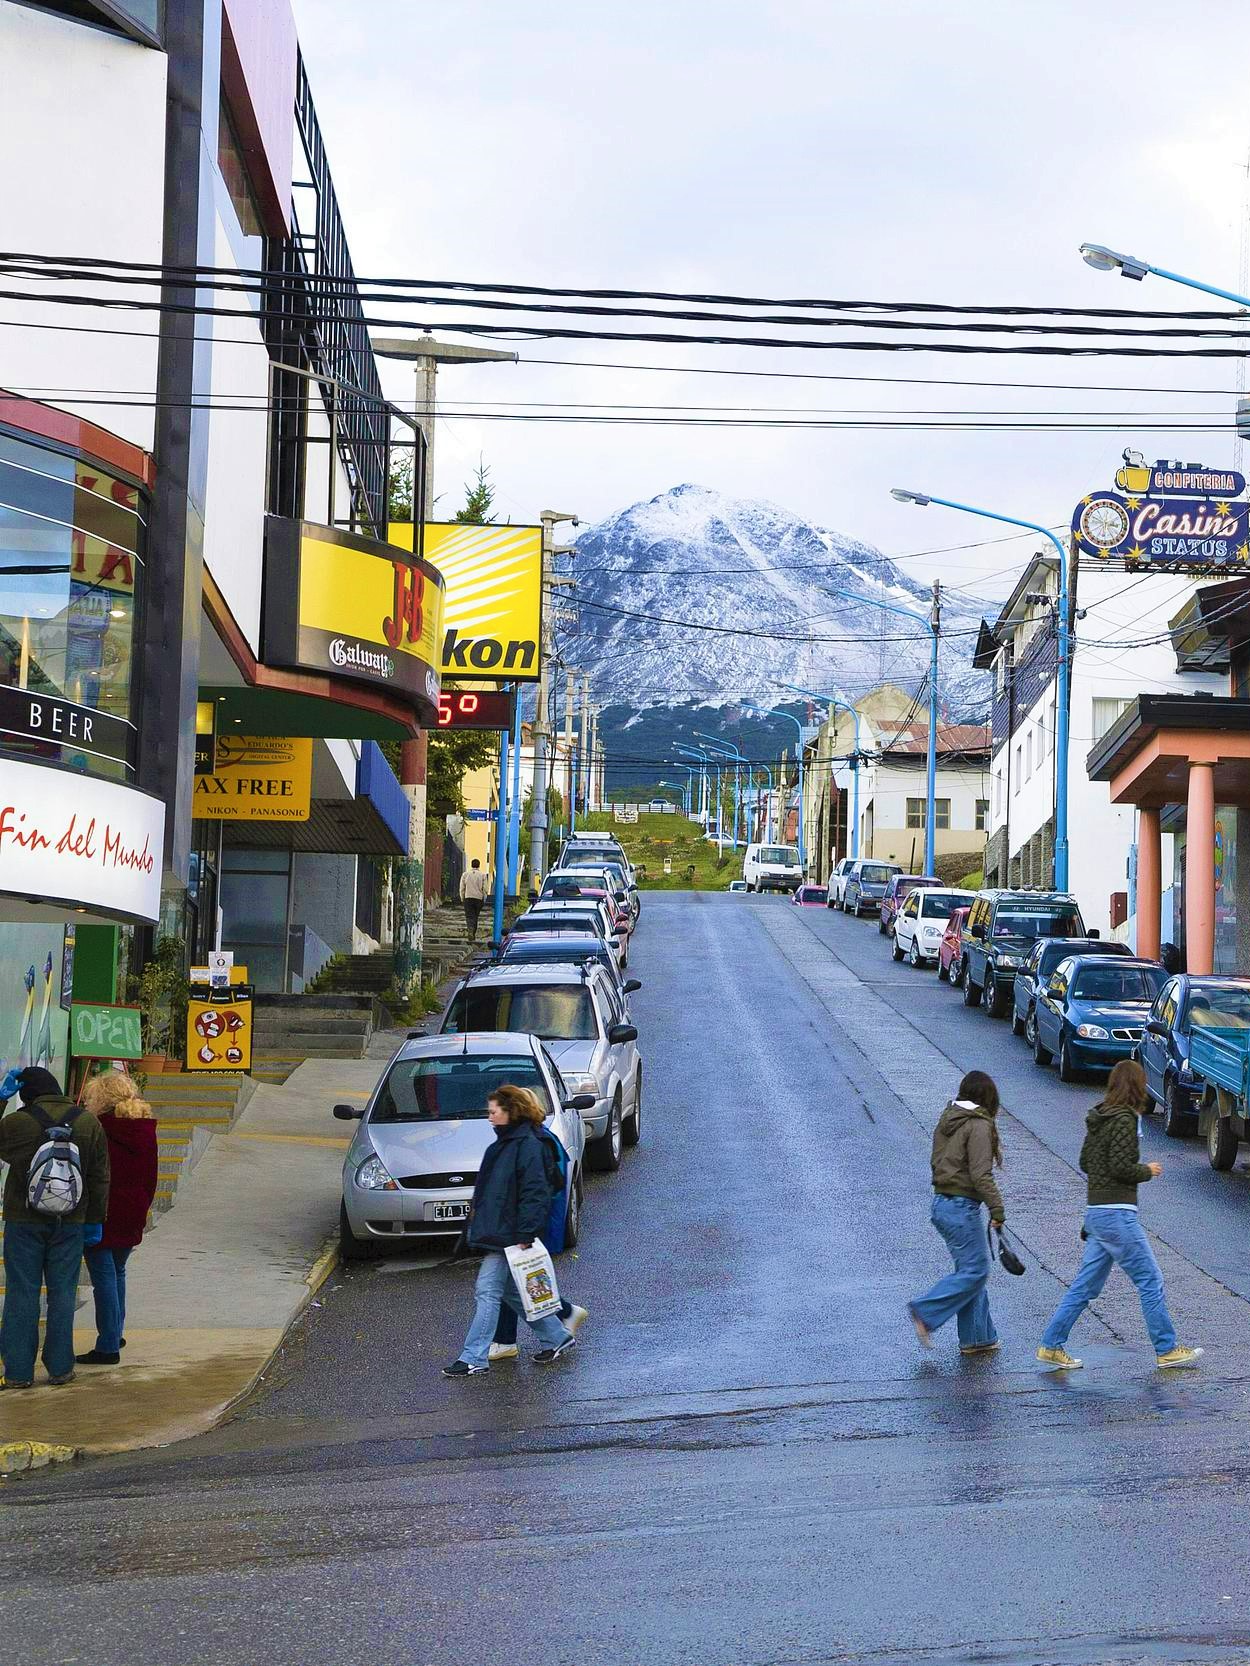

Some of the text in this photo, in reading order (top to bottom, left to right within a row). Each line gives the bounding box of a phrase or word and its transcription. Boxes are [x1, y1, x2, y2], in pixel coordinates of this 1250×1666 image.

[1153, 471, 1236, 490] CONFITERIA
[1131, 502, 1239, 542] Casino
[1150, 537, 1228, 557] STATUS
[383, 561, 425, 650] J&B
[329, 638, 389, 679] Galway
[442, 629, 537, 669] kon
[29, 702, 93, 743] BEER
[237, 779, 294, 797] FREE
[207, 806, 305, 817] NIKON PANASONIC
[0, 806, 154, 874] Fin del Mundo
[76, 1010, 141, 1051] OPEN
[435, 1206, 454, 1218] ETA
